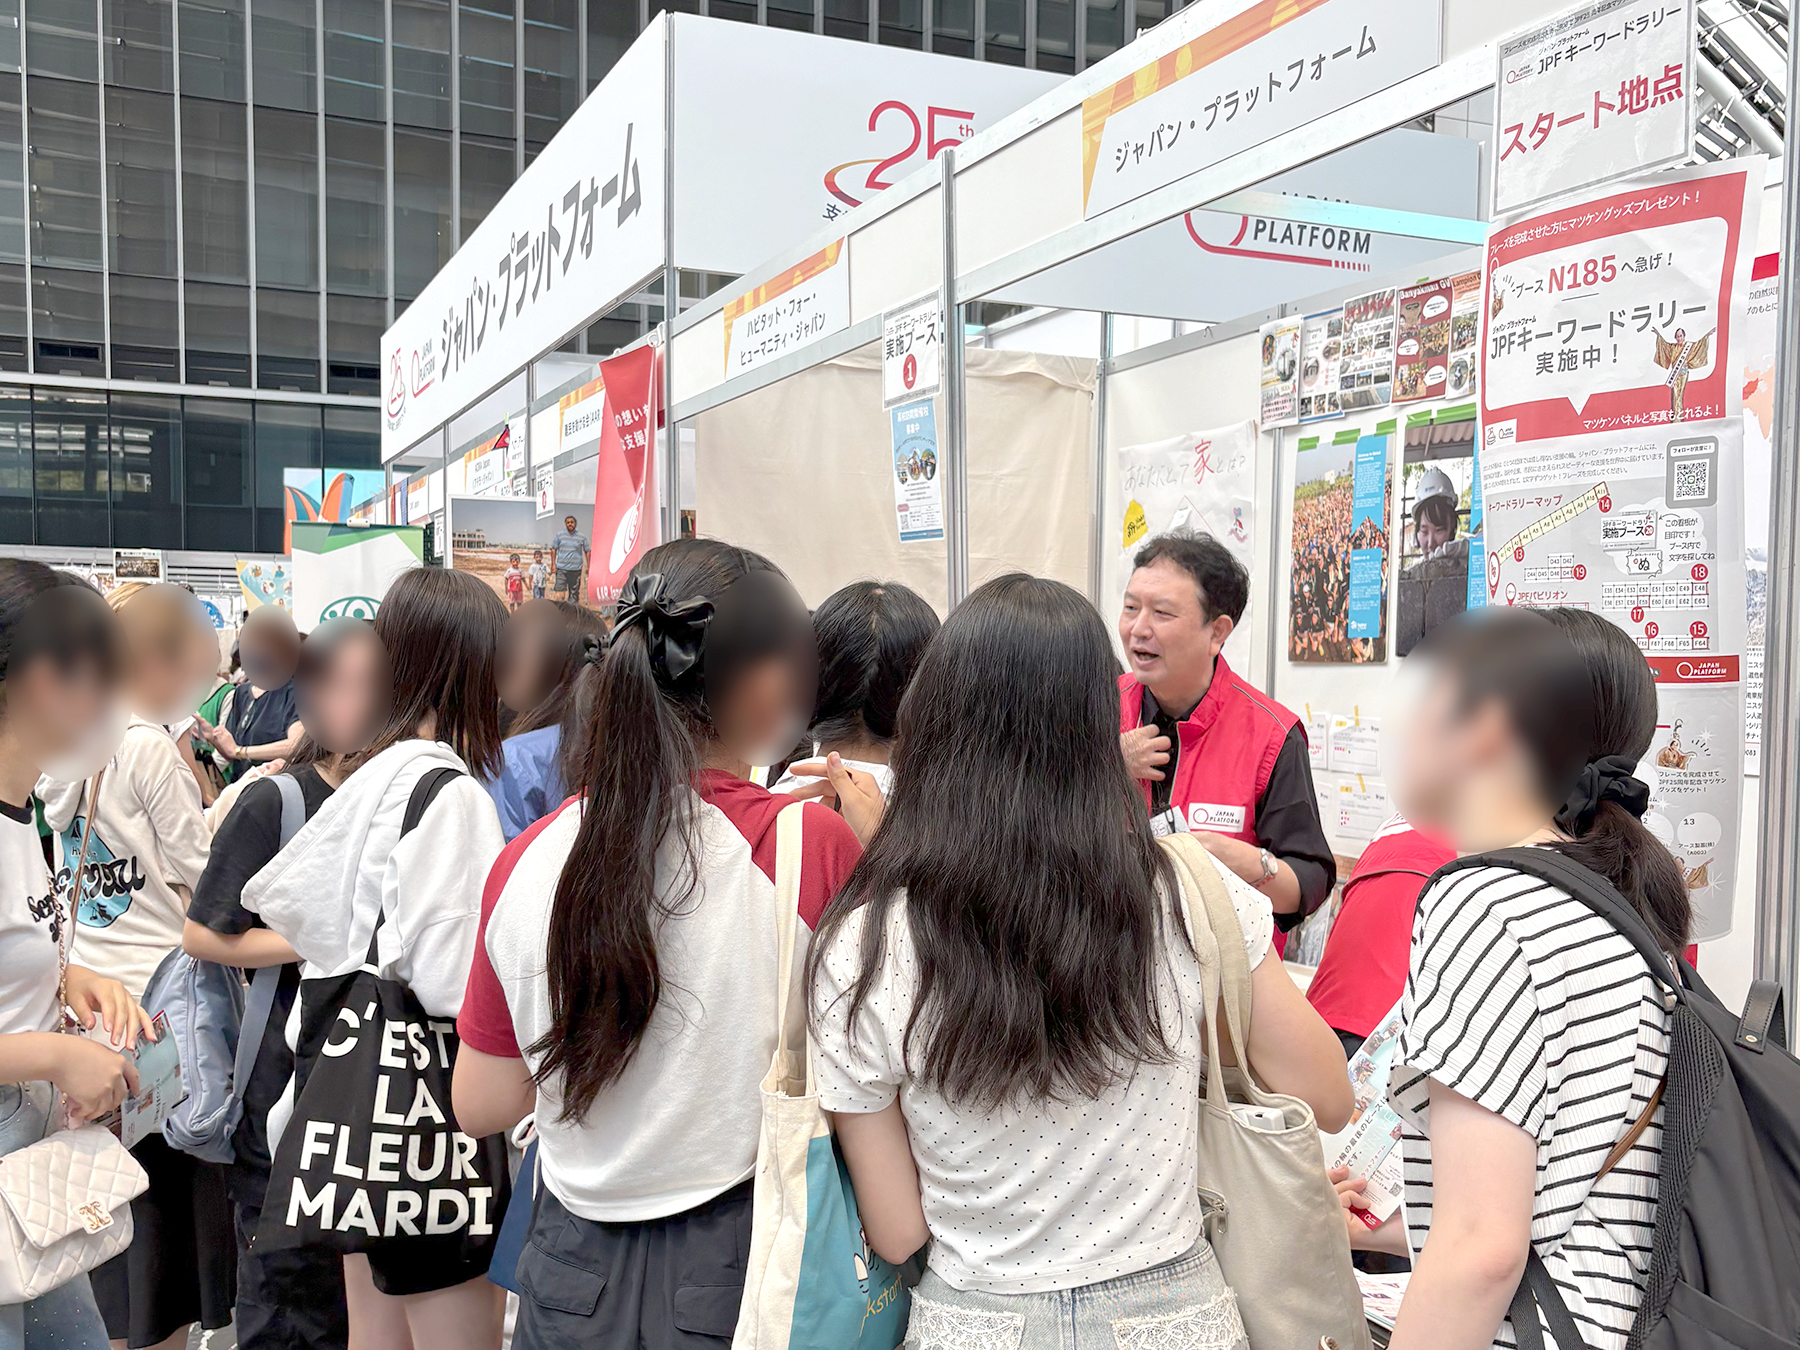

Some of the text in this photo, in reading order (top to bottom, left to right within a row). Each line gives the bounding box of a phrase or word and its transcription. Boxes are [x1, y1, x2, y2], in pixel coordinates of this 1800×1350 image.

[1115, 25, 1377, 173] ジャパン・プラットフォーム
[1500, 63, 1684, 161] スタート地点
[441, 122, 642, 383] ジャパン・プラットフォーム
[1252, 218, 1372, 255] PLATFORM
[1548, 255, 1618, 294] N185
[1621, 252, 1674, 277] へ急げ！
[1747, 303, 1778, 315] のもとに
[740, 312, 826, 366] ヒューマニティ・ジャパン
[886, 322, 937, 361] 実施ブース
[1490, 300, 1707, 360] JPFキーワードラリー
[1535, 344, 1618, 376] 実施中！
[1600, 497, 1610, 510] 14
[1515, 548, 1524, 559] 13
[1575, 566, 1586, 577] 19
[1693, 567, 1706, 578] 18
[1633, 608, 1642, 620] 17
[1646, 624, 1656, 635] 16
[1692, 624, 1704, 635] 15
[1209, 816, 1240, 824] PLATFORM
[321, 1001, 454, 1070] C'EST
[372, 1074, 447, 1127] LA
[300, 1120, 480, 1183] FLEUR
[1331, 1095, 1389, 1170] の輪の最後のピースは
[285, 1176, 493, 1237] MARDI
